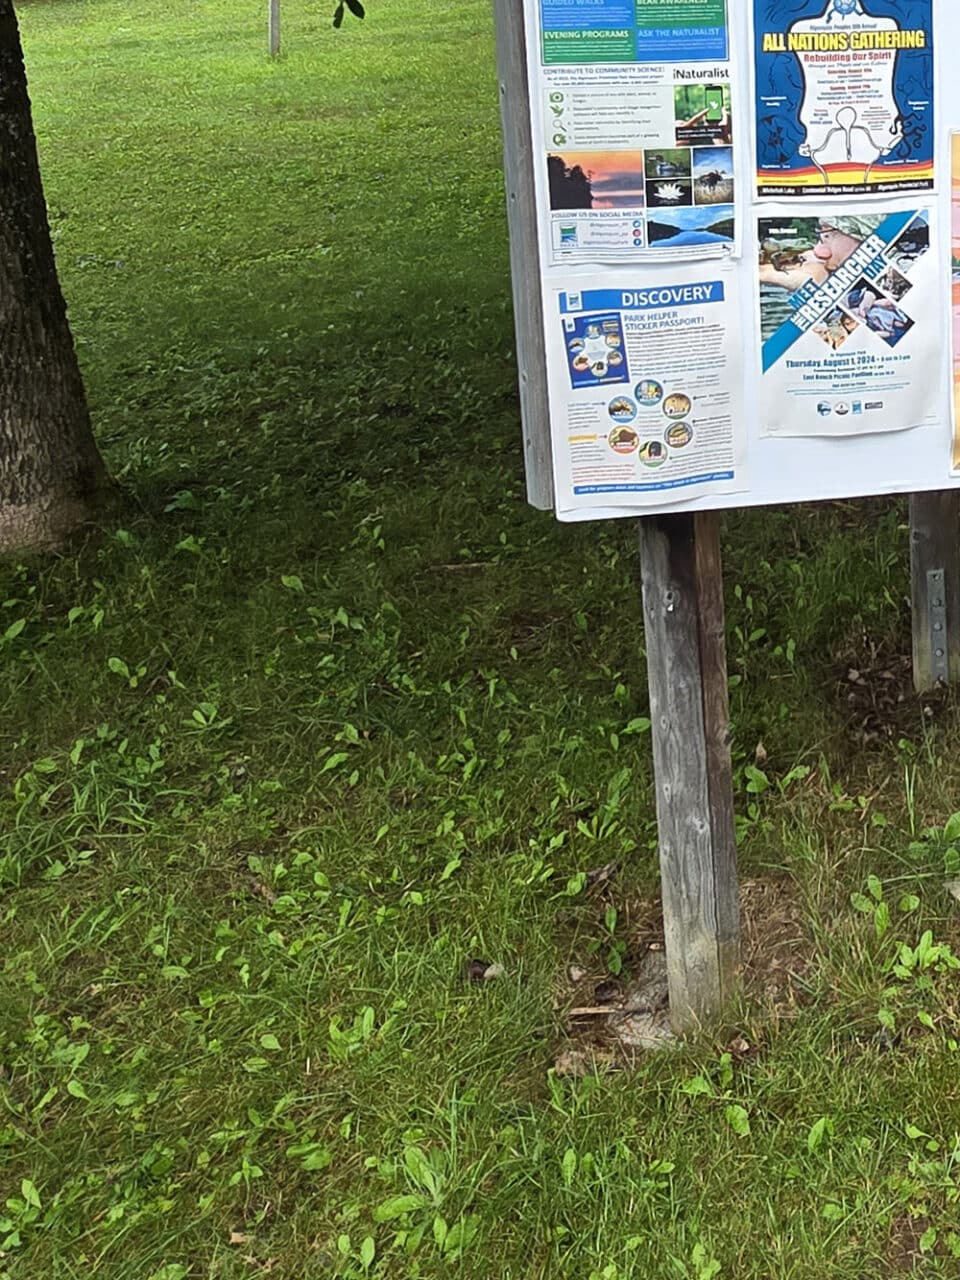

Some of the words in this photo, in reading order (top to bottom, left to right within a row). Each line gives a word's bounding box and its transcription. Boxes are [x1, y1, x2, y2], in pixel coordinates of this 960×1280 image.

[544, 31, 581, 39] EVENING
[582, 31, 629, 39] PROGRAMS
[763, 33, 786, 51] ALL
[788, 32, 848, 51] NATIONS
[850, 31, 925, 50] GATHERING
[804, 54, 850, 63] Rebuilding
[852, 53, 867, 61] Our
[868, 52, 892, 61] Spirit
[673, 68, 730, 80] iNaturalist
[862, 254, 889, 281] DAY
[800, 234, 888, 324] RESEARCHER
[622, 285, 714, 307] DISCOVERY
[788, 279, 820, 310] MEET
[624, 314, 646, 322] PARK
[648, 312, 678, 321] HELPER
[625, 321, 659, 331] STICKER
[824, 358, 850, 368] August
[857, 356, 875, 364] 2024
